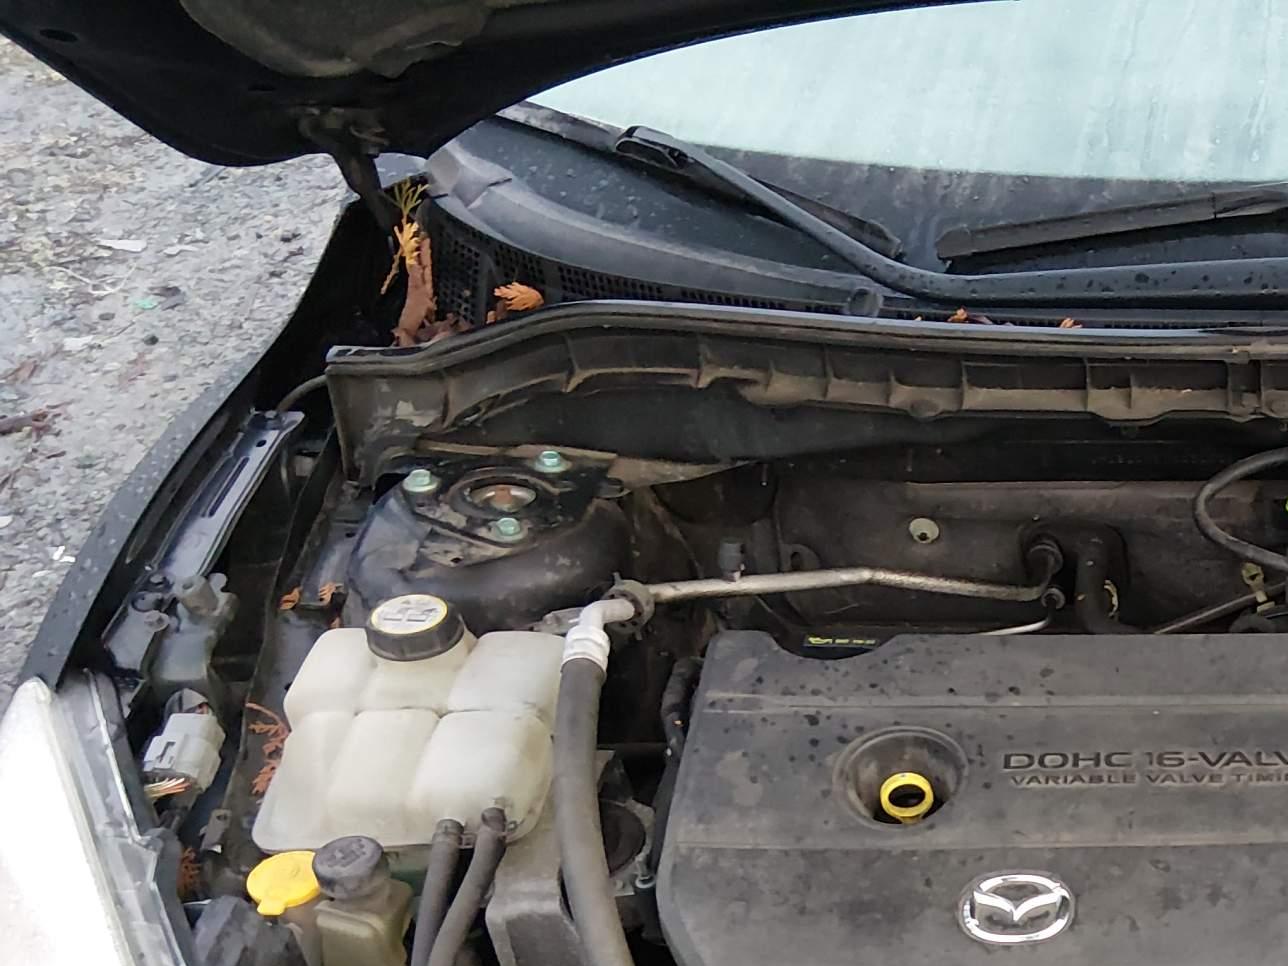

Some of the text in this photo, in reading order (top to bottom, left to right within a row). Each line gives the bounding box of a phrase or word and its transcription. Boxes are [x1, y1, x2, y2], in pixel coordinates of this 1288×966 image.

[1002, 751, 1133, 770] DOHC
[1010, 772, 1137, 786] VARIABLE
[1147, 772, 1224, 785] VALVE
